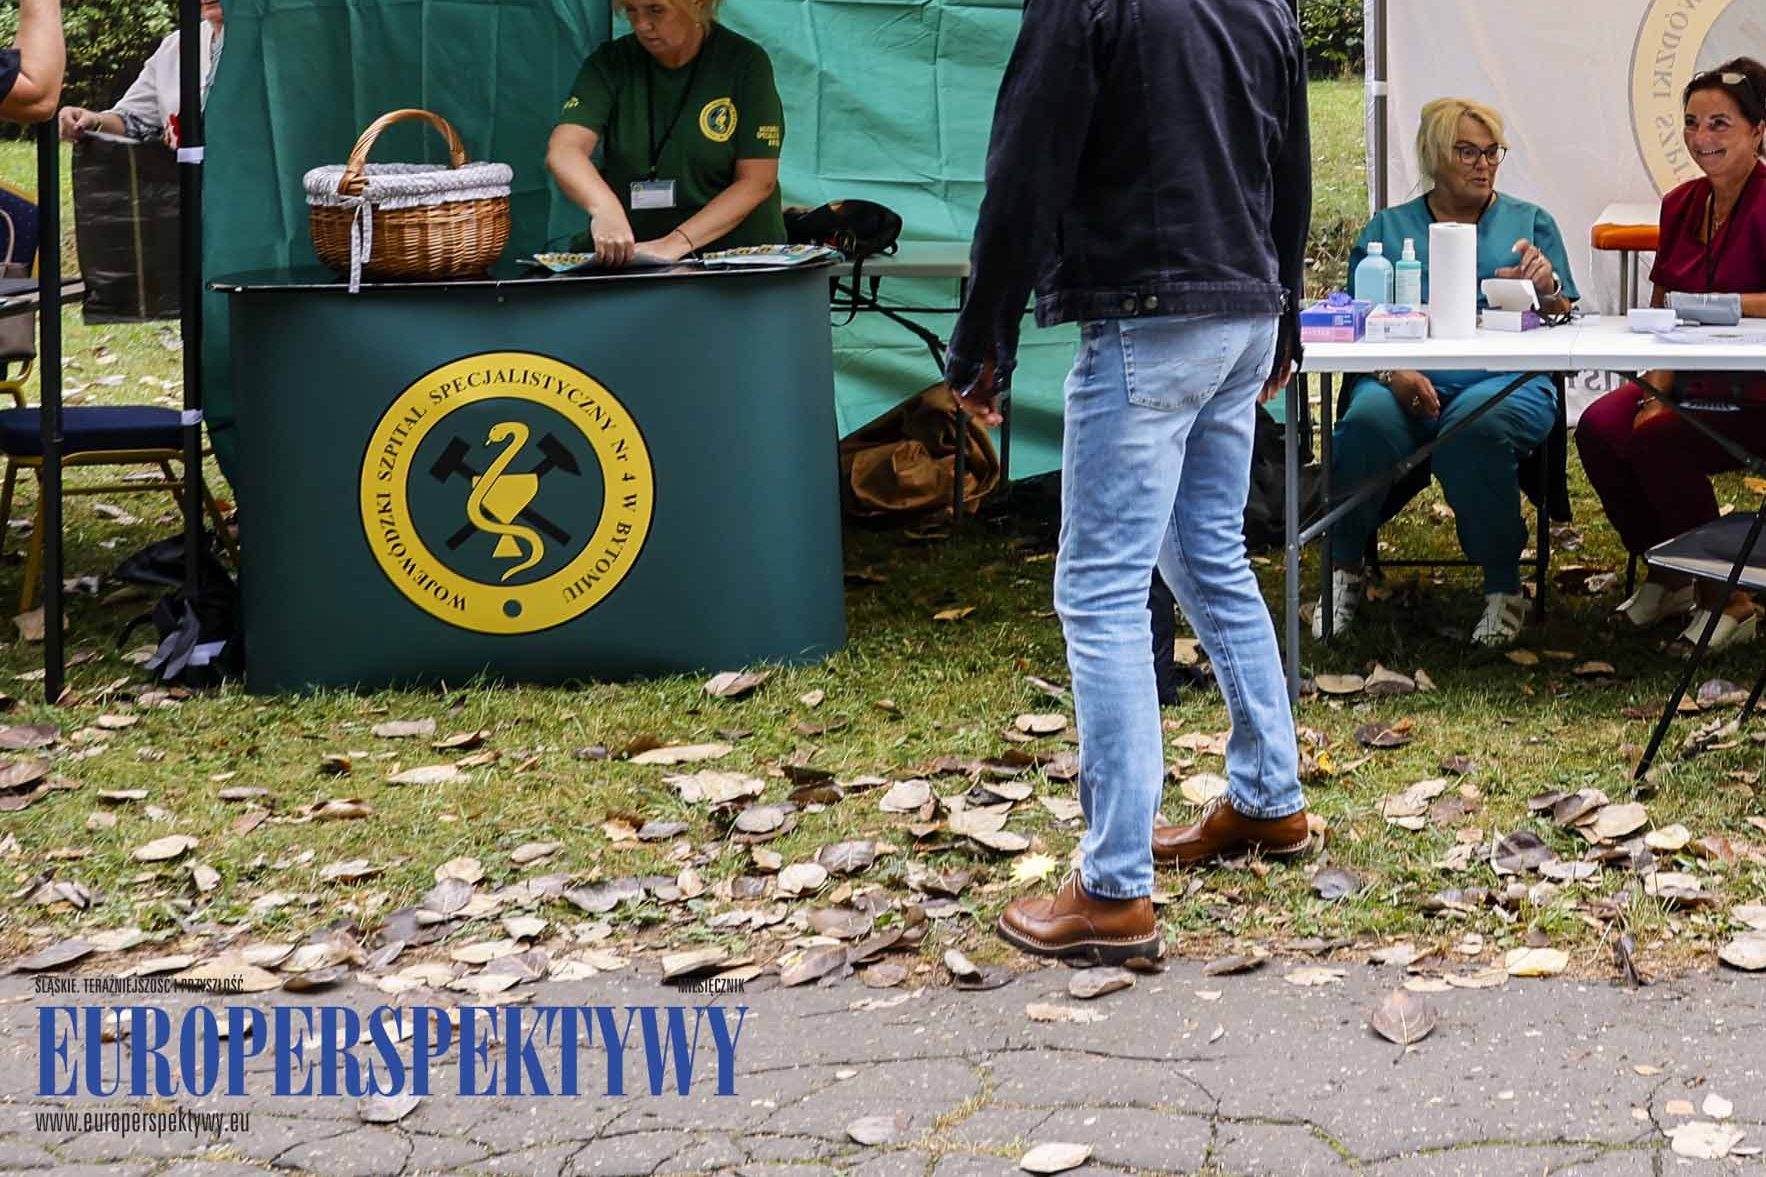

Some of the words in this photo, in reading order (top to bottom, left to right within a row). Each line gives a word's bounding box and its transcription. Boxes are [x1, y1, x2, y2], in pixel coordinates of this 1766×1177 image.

[428, 368, 617, 432] SPECJALISTYCZNY
[378, 404, 429, 483] SZPITAL
[610, 437, 629, 463] Nr
[621, 471, 637, 482] 4
[622, 493, 639, 513] W
[375, 491, 468, 612] WOJEWÓDZKI
[562, 522, 633, 604] BYTOMIU
